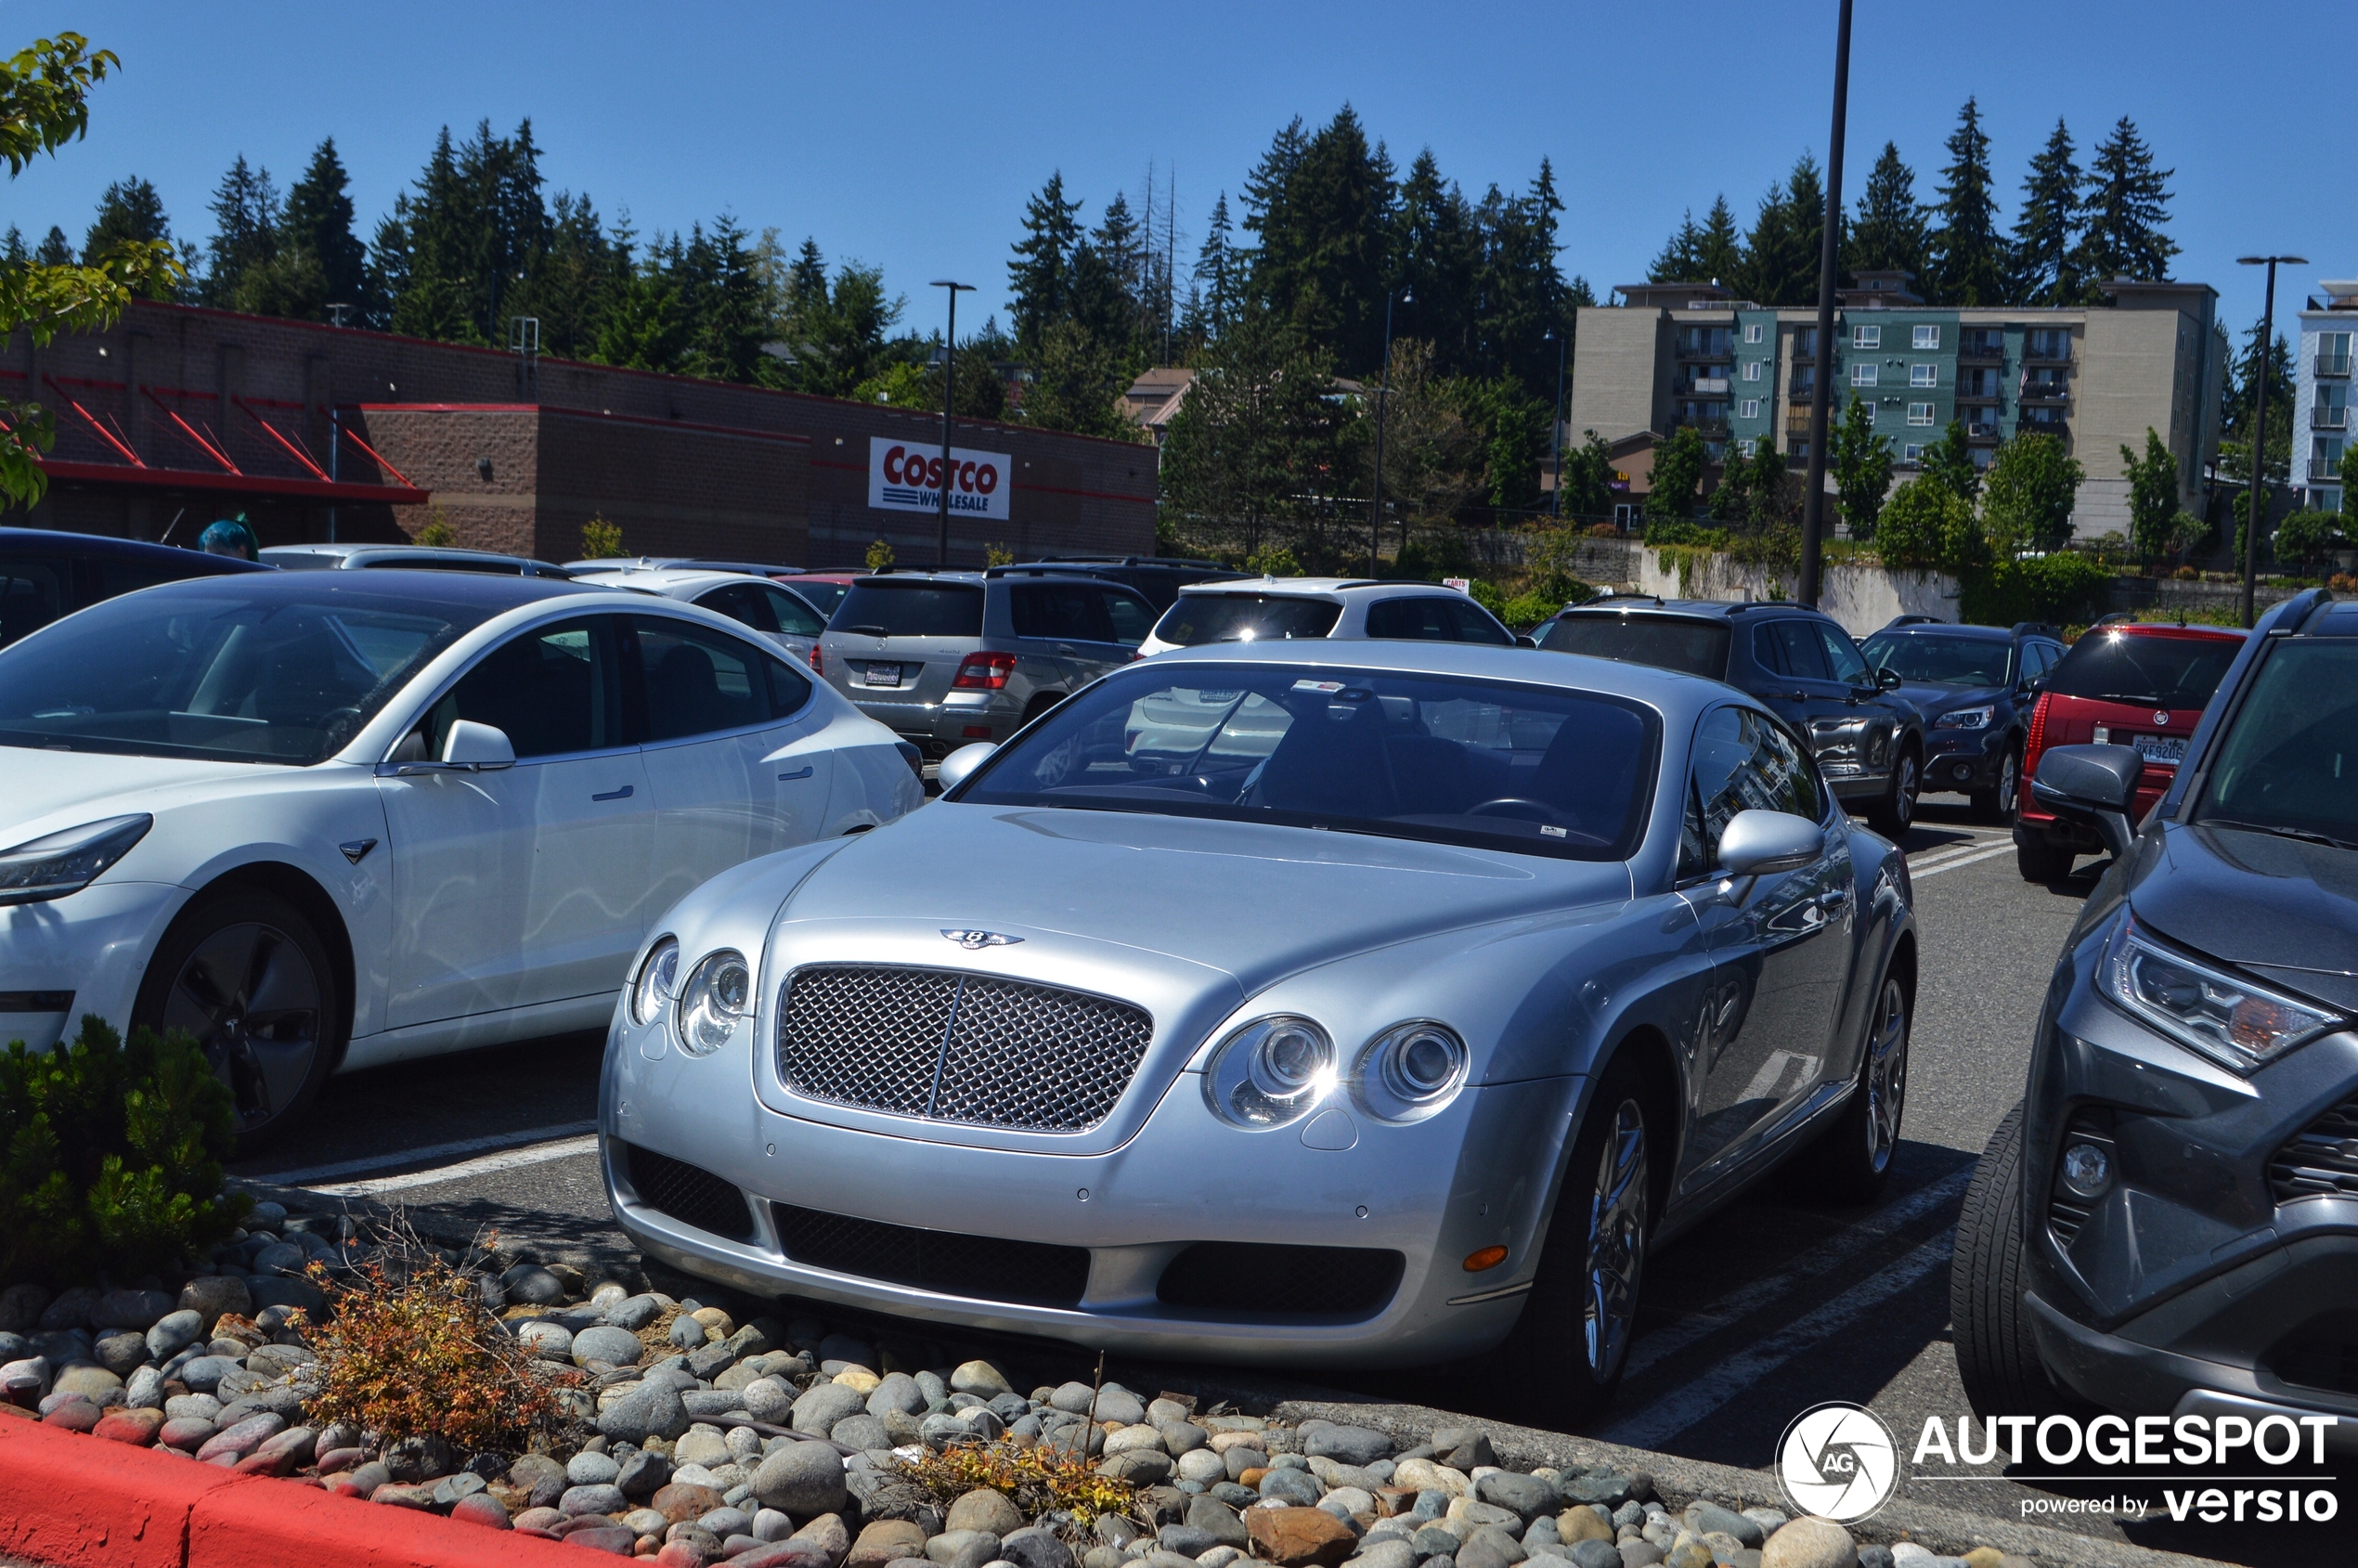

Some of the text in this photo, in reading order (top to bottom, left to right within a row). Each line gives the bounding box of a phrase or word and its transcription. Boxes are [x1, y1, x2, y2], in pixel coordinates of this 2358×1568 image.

[884, 446, 998, 495] COSTCO
[919, 491, 989, 512] WHLESALE
[1446, 579, 1466, 588] CARTS
